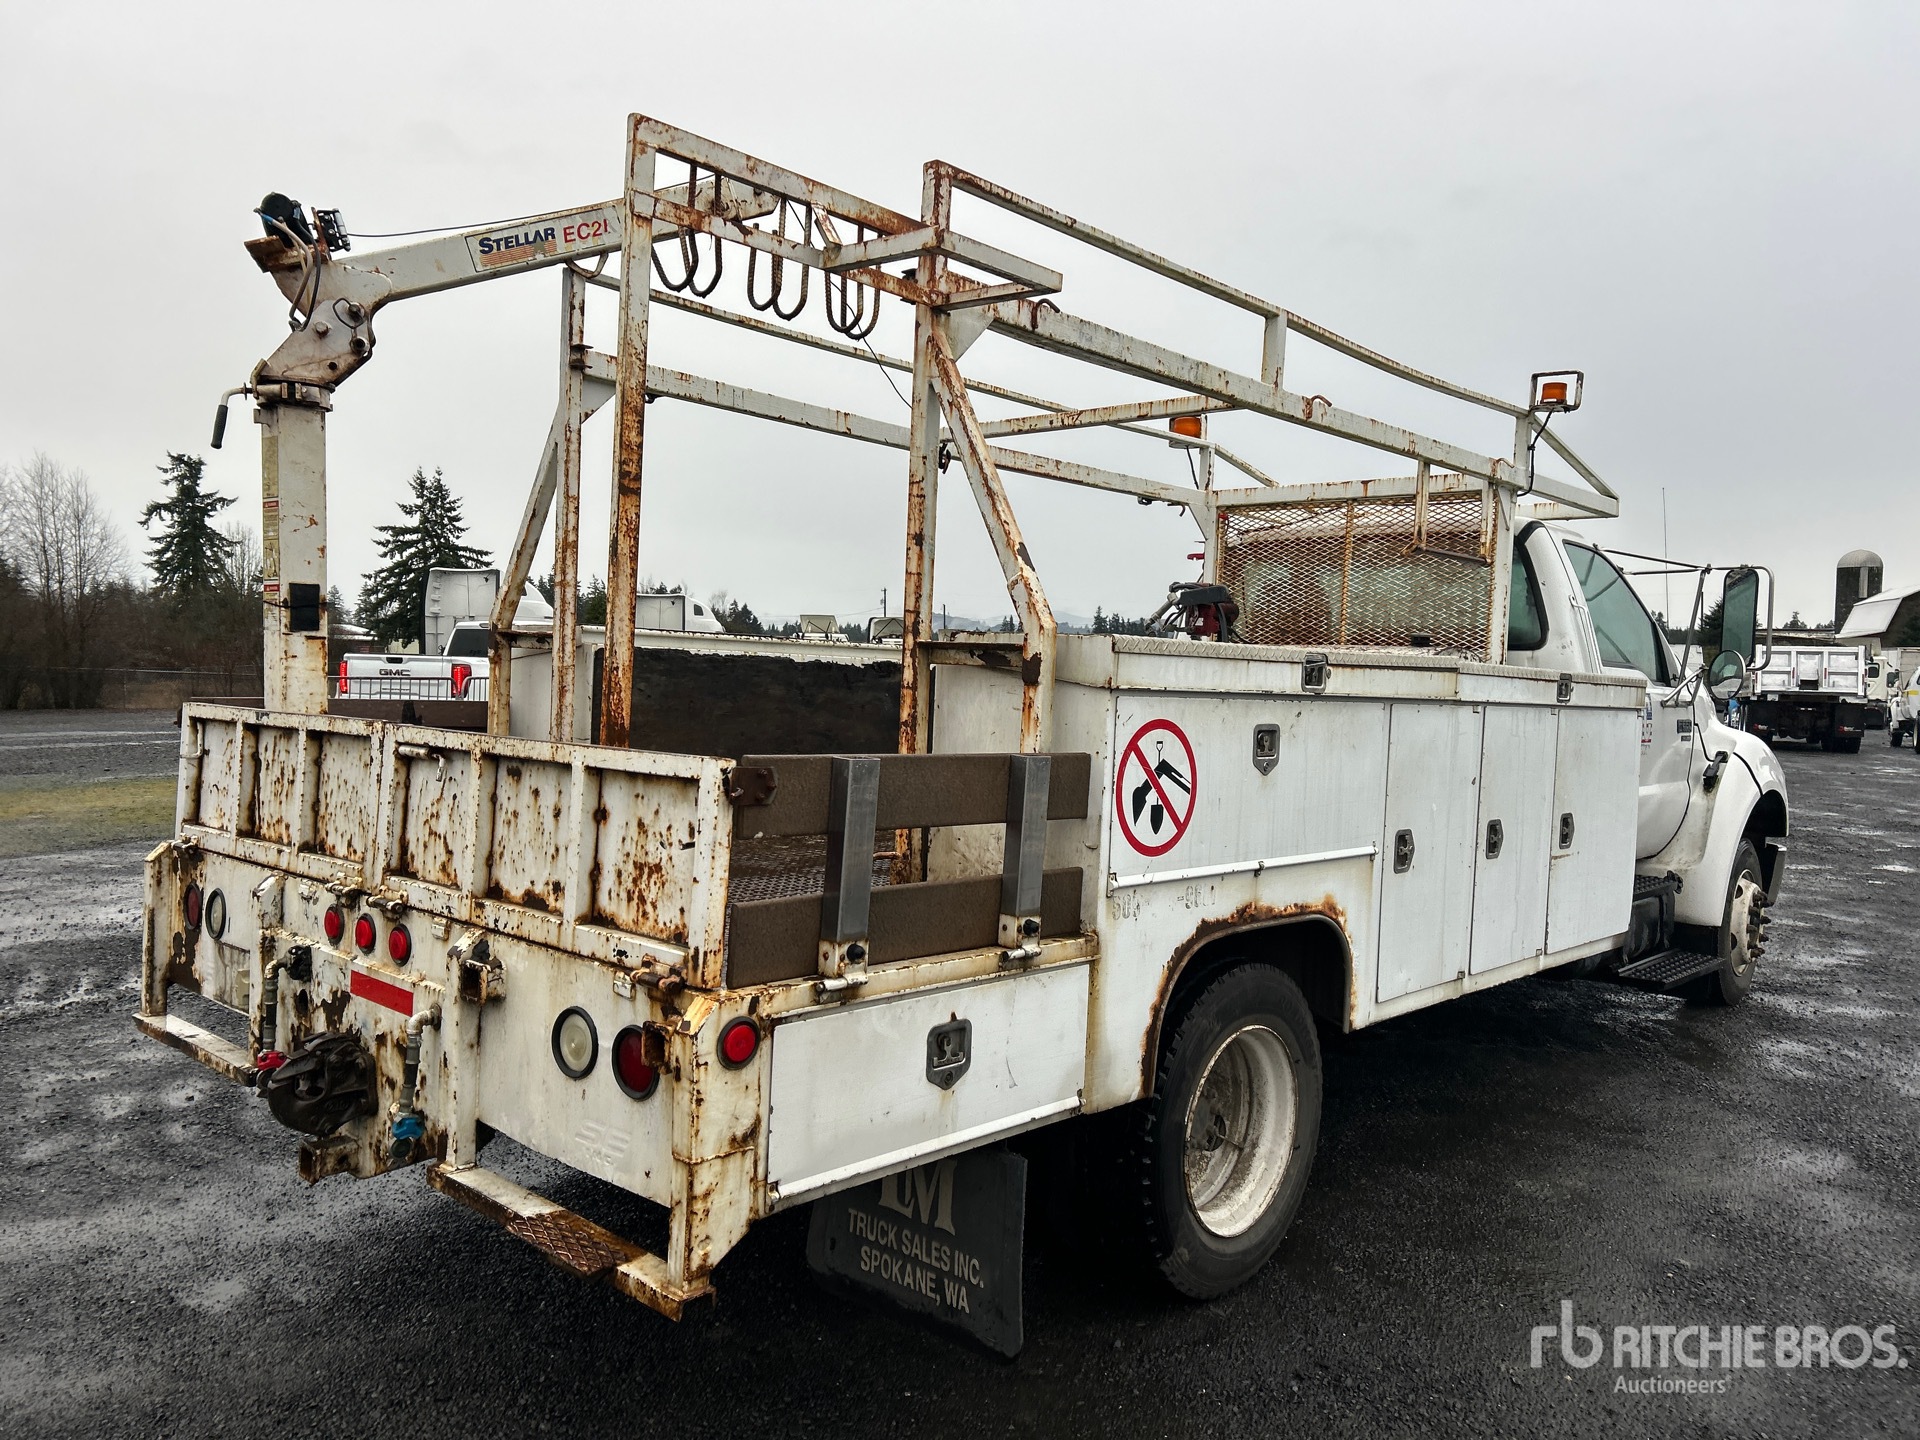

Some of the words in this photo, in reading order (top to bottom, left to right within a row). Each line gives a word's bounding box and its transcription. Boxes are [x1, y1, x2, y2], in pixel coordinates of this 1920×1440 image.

[478, 226, 556, 255] STELLAR
[379, 668, 411, 676] GMC
[848, 1208, 898, 1250] TRUCK
[901, 1229, 951, 1272] SALES
[953, 1250, 984, 1288] INC.
[860, 1245, 941, 1306] SPOKANE,
[943, 1277, 970, 1314] WA
